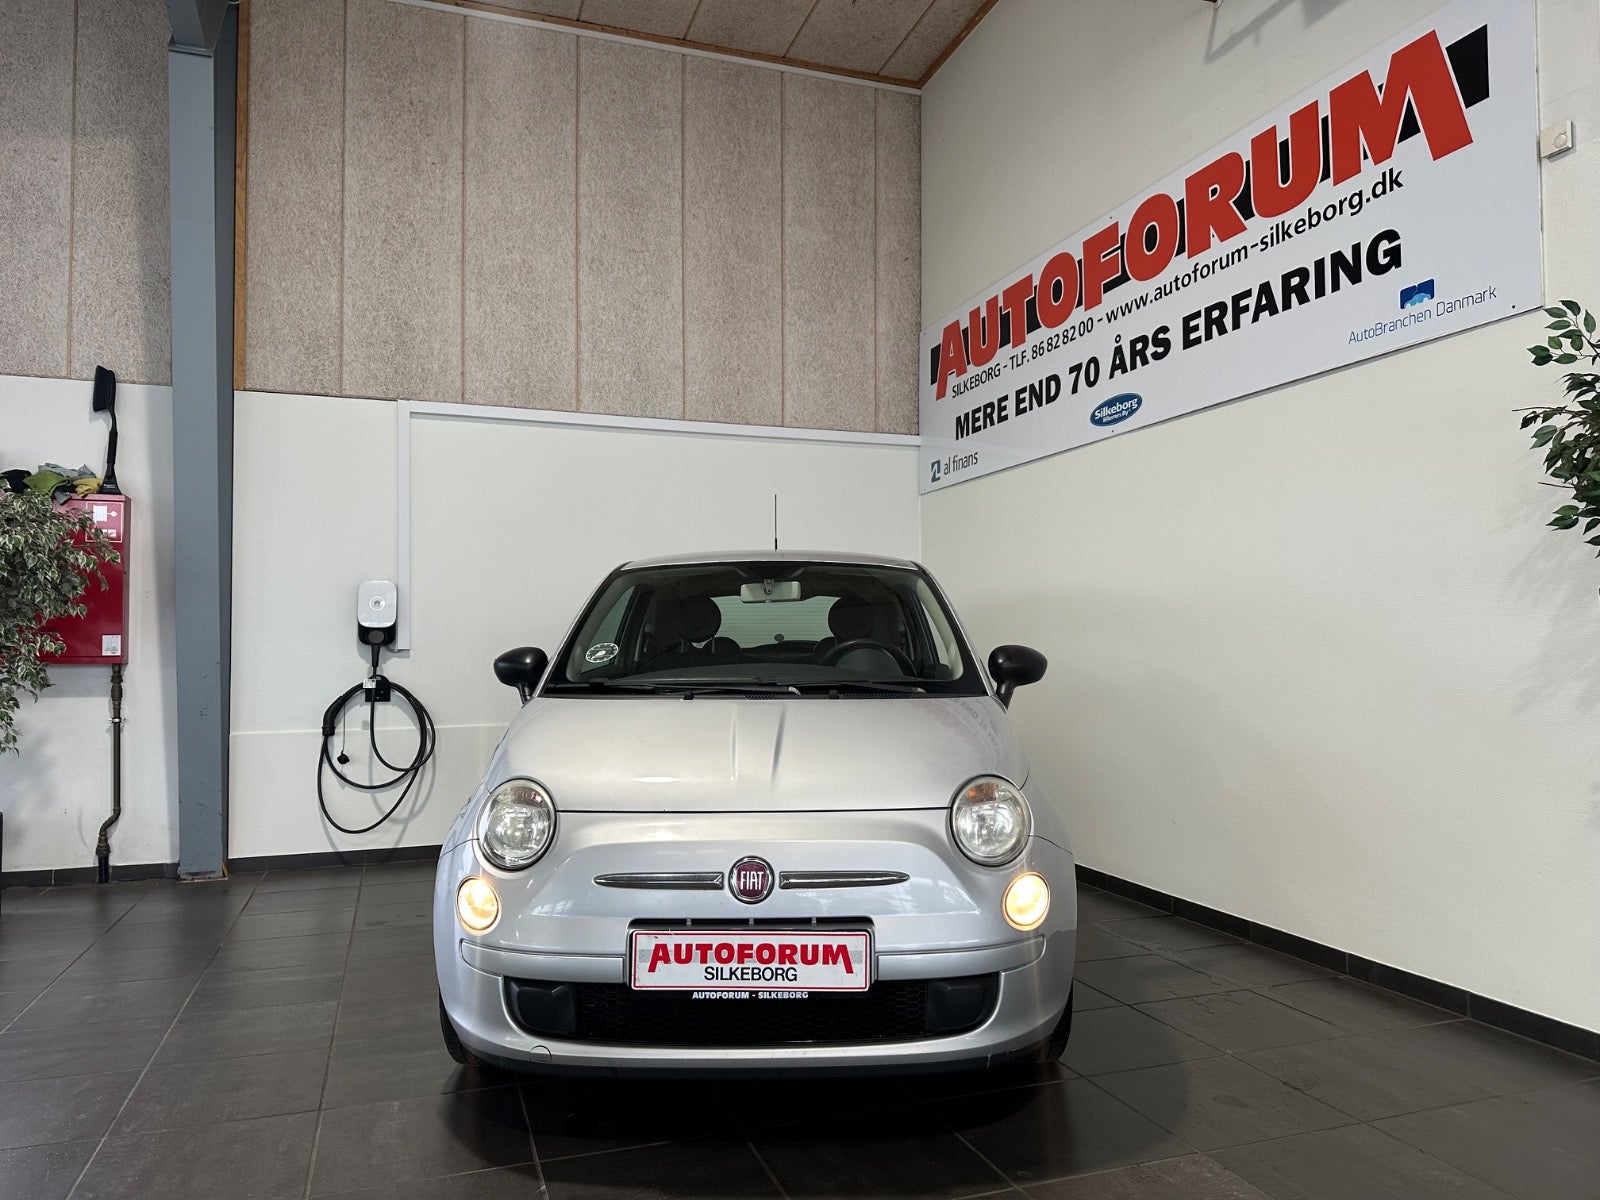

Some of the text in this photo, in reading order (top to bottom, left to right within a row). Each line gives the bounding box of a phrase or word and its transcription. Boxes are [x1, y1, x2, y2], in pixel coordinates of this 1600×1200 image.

[935, 29, 1473, 401] AUTOFORUM
[952, 363, 1001, 398] SILKEBORG
[1009, 350, 1030, 370] TLF.
[1105, 167, 1405, 324] www.autoforum-silkeborg.dk
[1348, 285, 1497, 345] AutoBranchen Danmark
[955, 228, 1402, 441] MERE END 70 ÅRS ERFARING
[1094, 398, 1138, 420] Silkeborg
[944, 452, 978, 475] al finans
[740, 871, 764, 891] FIAT
[647, 942, 854, 974] AUTOFORUM
[704, 965, 798, 982] SILKEBORG
[692, 991, 750, 999] AUTOFORUM
[757, 991, 809, 999] SILKEBORG
